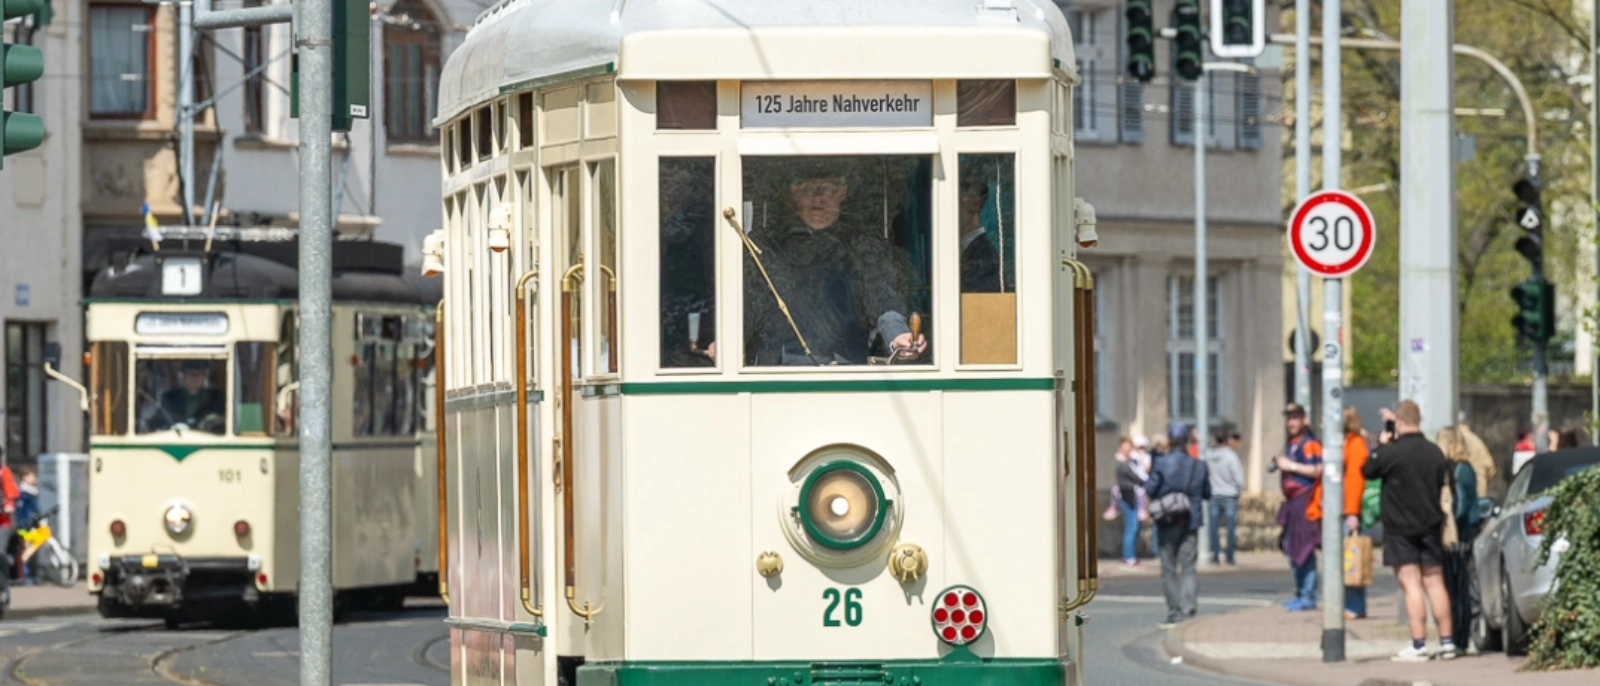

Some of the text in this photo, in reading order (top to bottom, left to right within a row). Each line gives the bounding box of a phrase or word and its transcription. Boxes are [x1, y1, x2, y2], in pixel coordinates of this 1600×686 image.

[756, 93, 920, 114] 125 Jahre Nahverkehr
[1308, 215, 1354, 251] 30
[179, 266, 186, 288] 1
[218, 468, 242, 483] 101
[823, 587, 863, 627] 26
